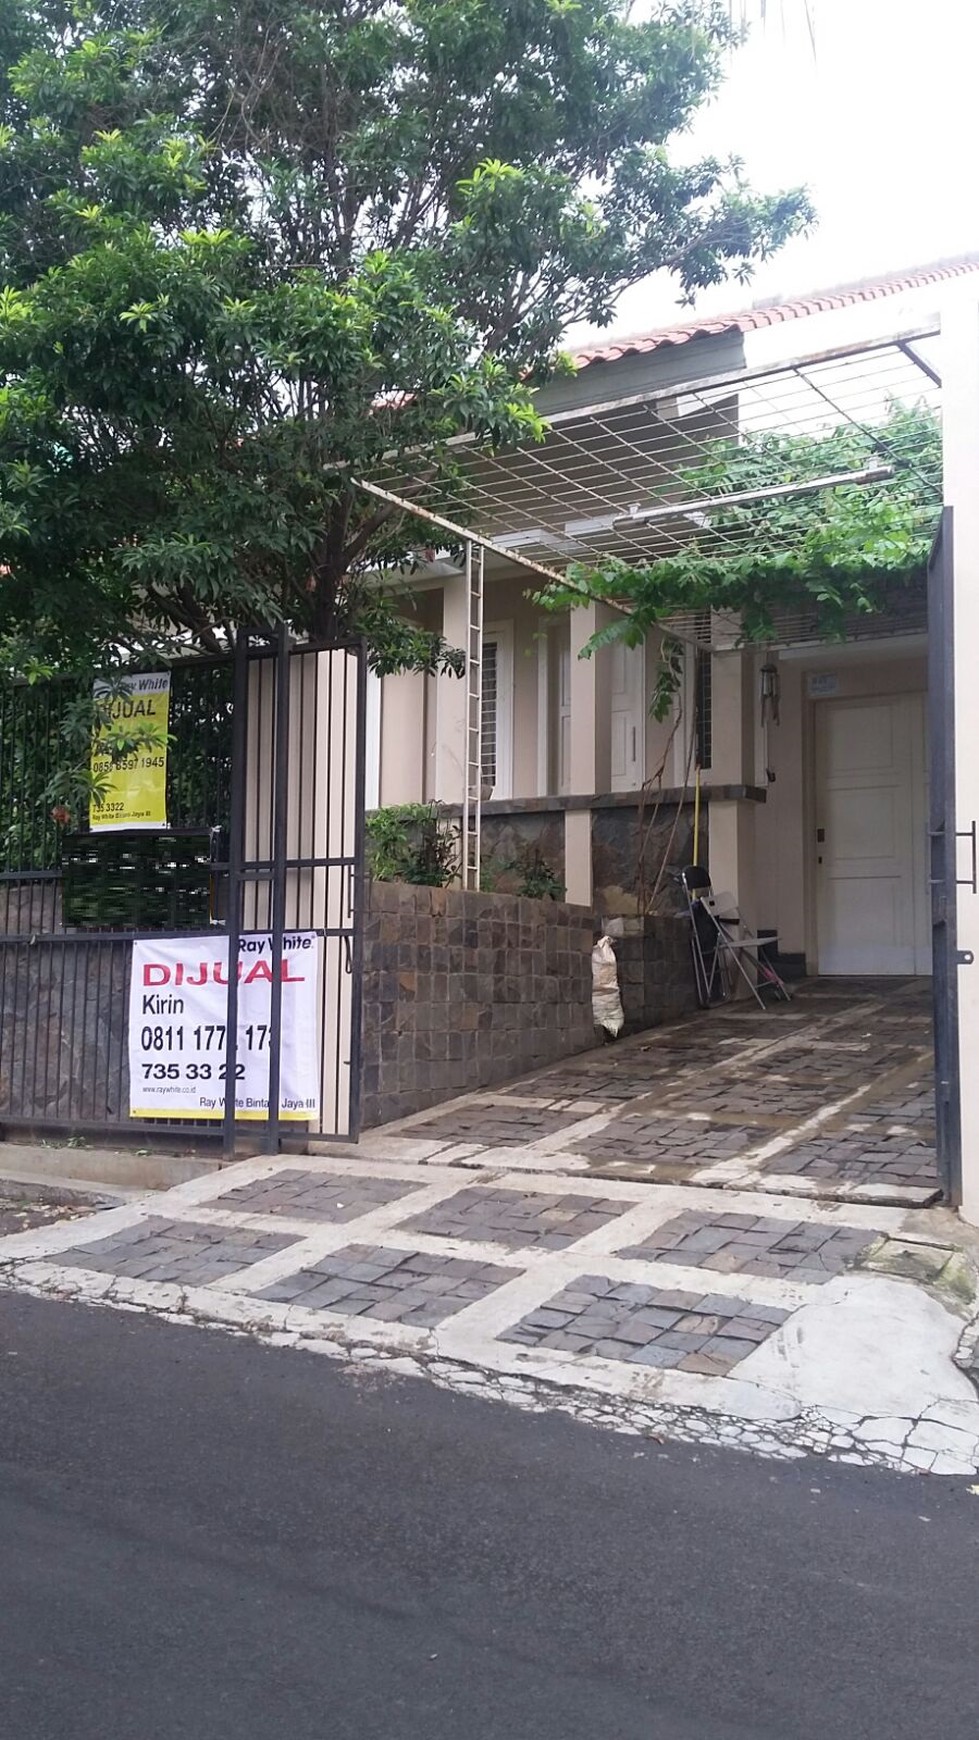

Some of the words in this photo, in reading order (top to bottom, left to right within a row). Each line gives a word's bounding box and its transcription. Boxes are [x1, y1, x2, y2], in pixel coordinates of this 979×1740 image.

[141, 756, 165, 768] 1945
[106, 802, 125, 812] 3322
[239, 938, 265, 954] Ray
[143, 959, 305, 987] DIJUAL
[142, 994, 184, 1014] Kirin
[141, 1025, 184, 1051] 0811
[141, 1063, 180, 1080] 735
[185, 1063, 212, 1080] 33
[199, 1096, 217, 1109] Ray
[281, 1098, 304, 1111] Jaya
